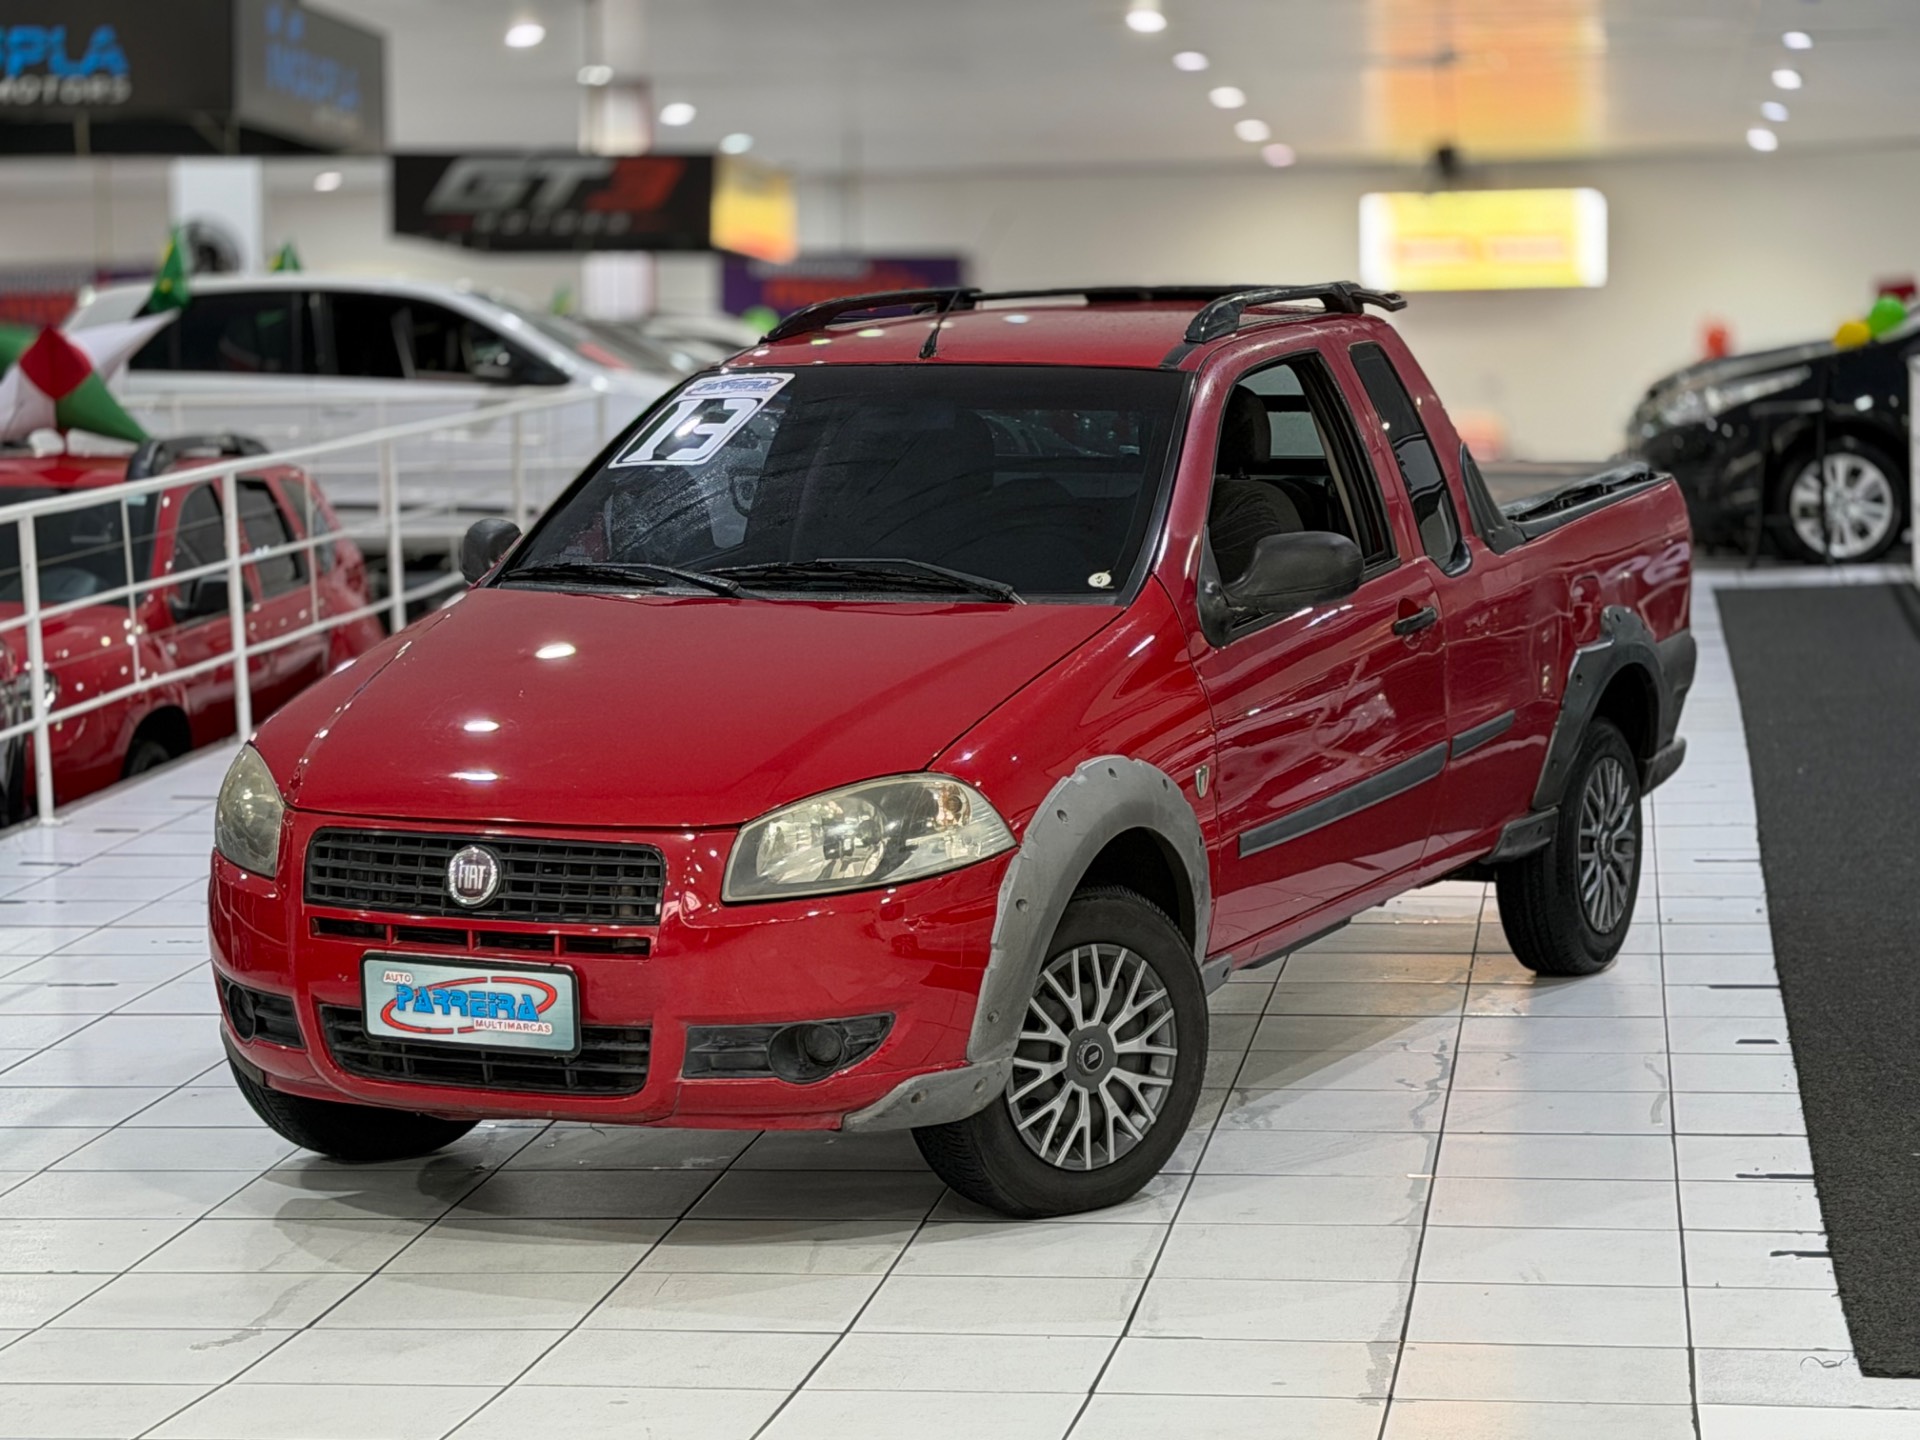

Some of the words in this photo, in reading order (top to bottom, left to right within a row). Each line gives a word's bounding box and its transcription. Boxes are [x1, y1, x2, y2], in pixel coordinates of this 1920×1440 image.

[0, 23, 130, 79] PLA
[621, 398, 759, 462] 13
[457, 864, 487, 890] FIAT
[384, 971, 412, 984] AUTO
[395, 983, 540, 1022] PARREIRA
[474, 1019, 552, 1034] MULTIMARCAS
